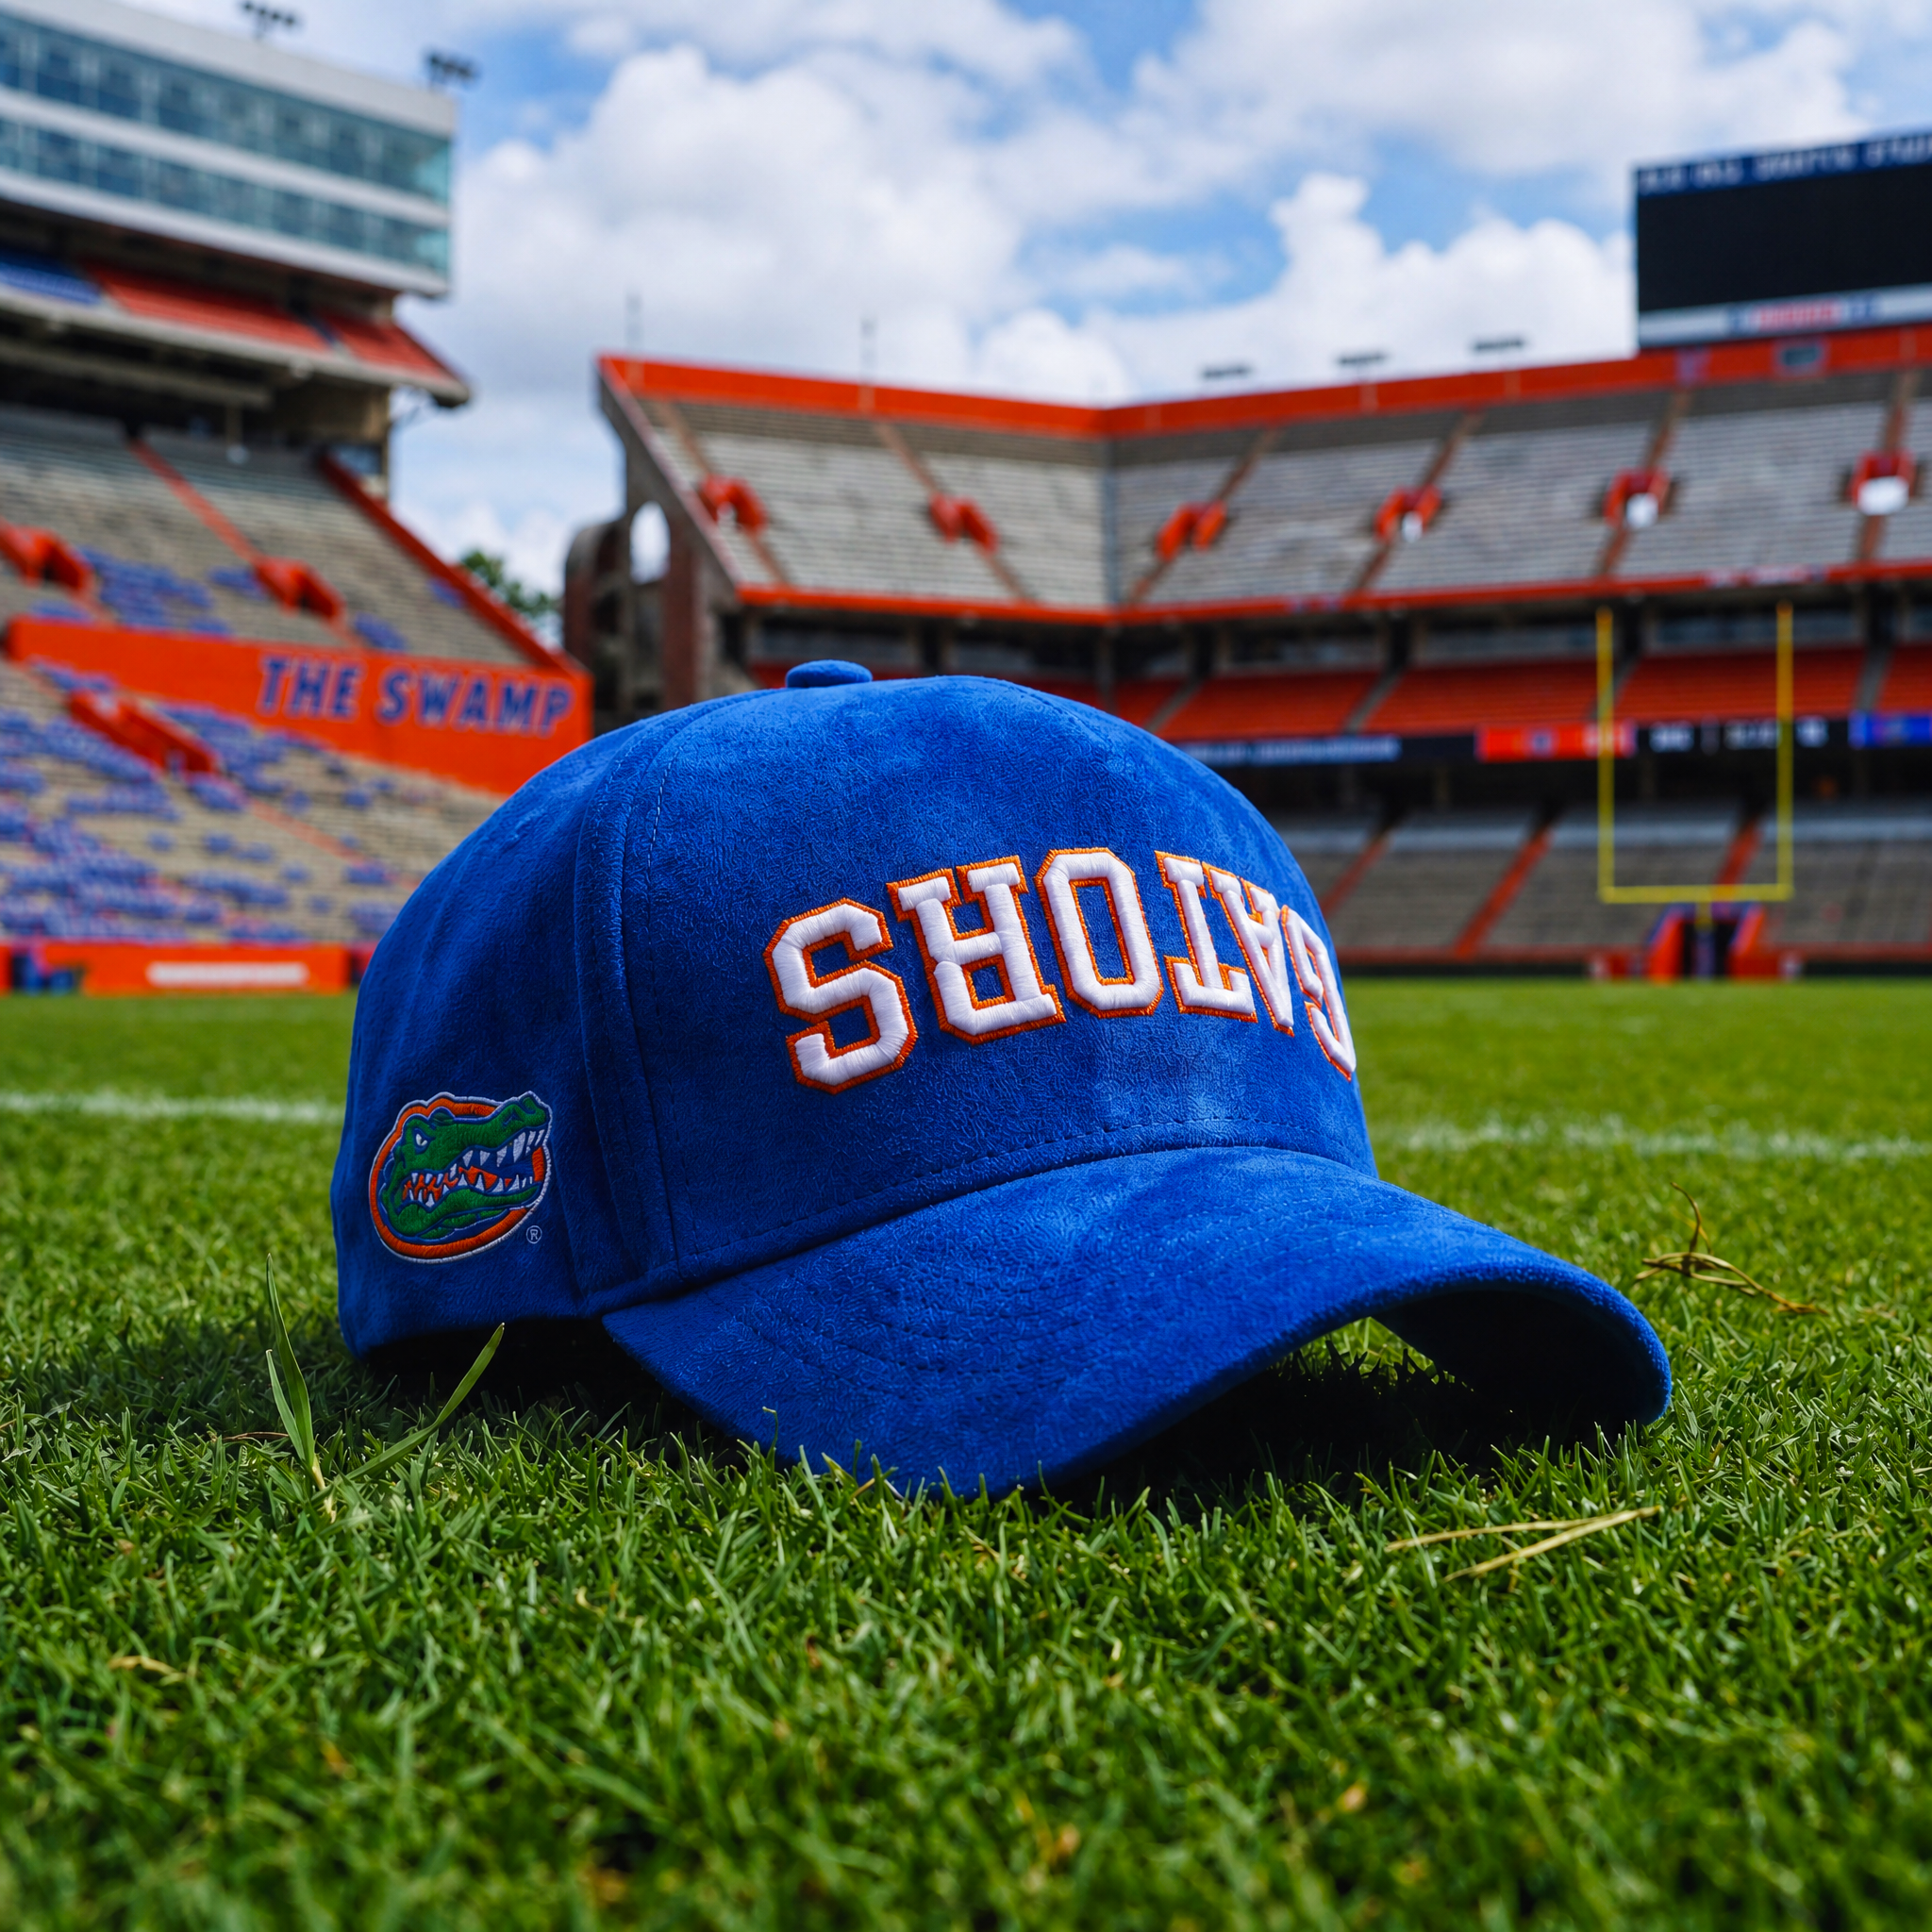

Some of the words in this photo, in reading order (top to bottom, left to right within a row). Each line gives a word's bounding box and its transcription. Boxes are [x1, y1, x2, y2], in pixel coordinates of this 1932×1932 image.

[259, 656, 361, 720] THE
[378, 669, 572, 735] SWAMP
[762, 847, 1357, 1094] GATORS
